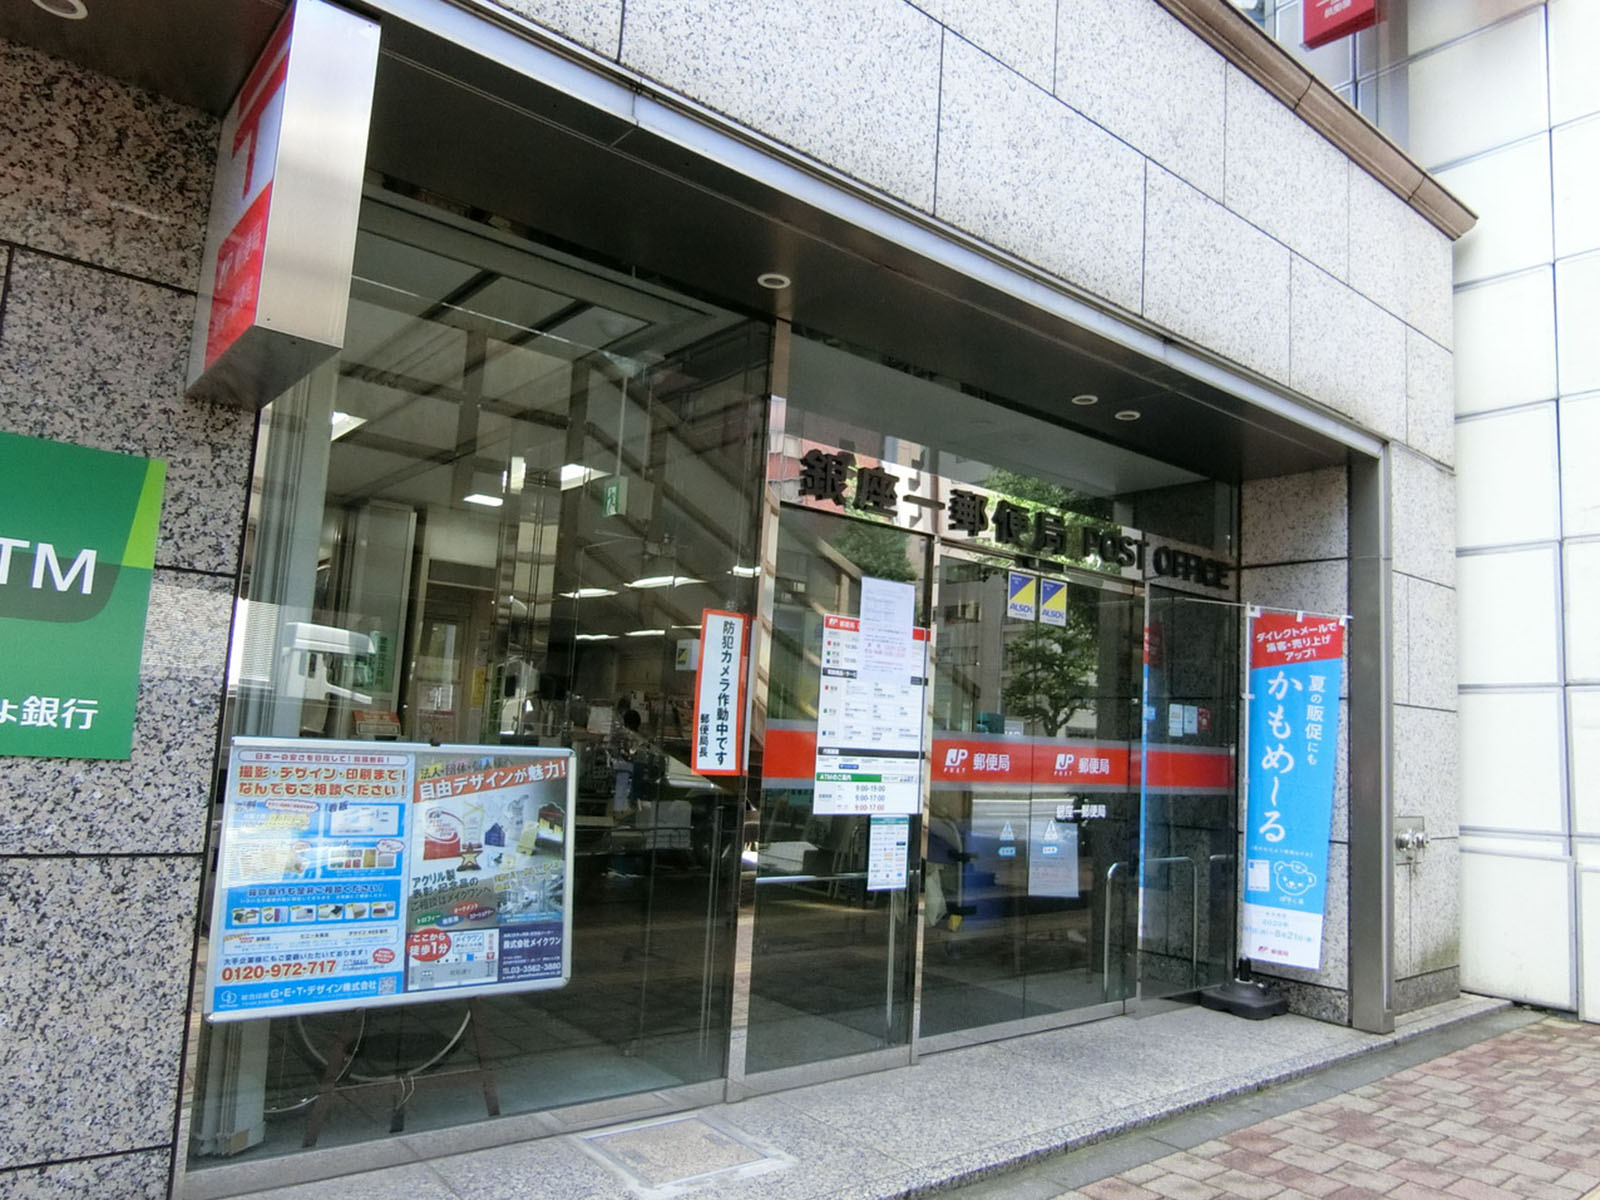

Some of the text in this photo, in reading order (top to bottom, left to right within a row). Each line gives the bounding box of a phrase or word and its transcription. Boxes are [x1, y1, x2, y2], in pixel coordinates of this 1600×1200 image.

[799, 449, 1230, 590] 銀座一郵便局 POST OFFICE
[1256, 622, 1337, 643] ダイレクトメールで
[1266, 634, 1331, 653] 集客・売り上げ
[715, 620, 735, 766] 防犯カメラ作動中です
[0, 695, 99, 730] ょ銀行
[1305, 675, 1327, 766] 夏の販促にも
[699, 713, 710, 758] 郵便局長
[973, 753, 1010, 772] 郵便局
[1078, 757, 1110, 774] 郵便局
[412, 933, 446, 942] ここから
[222, 960, 337, 982] 0120-972-717
